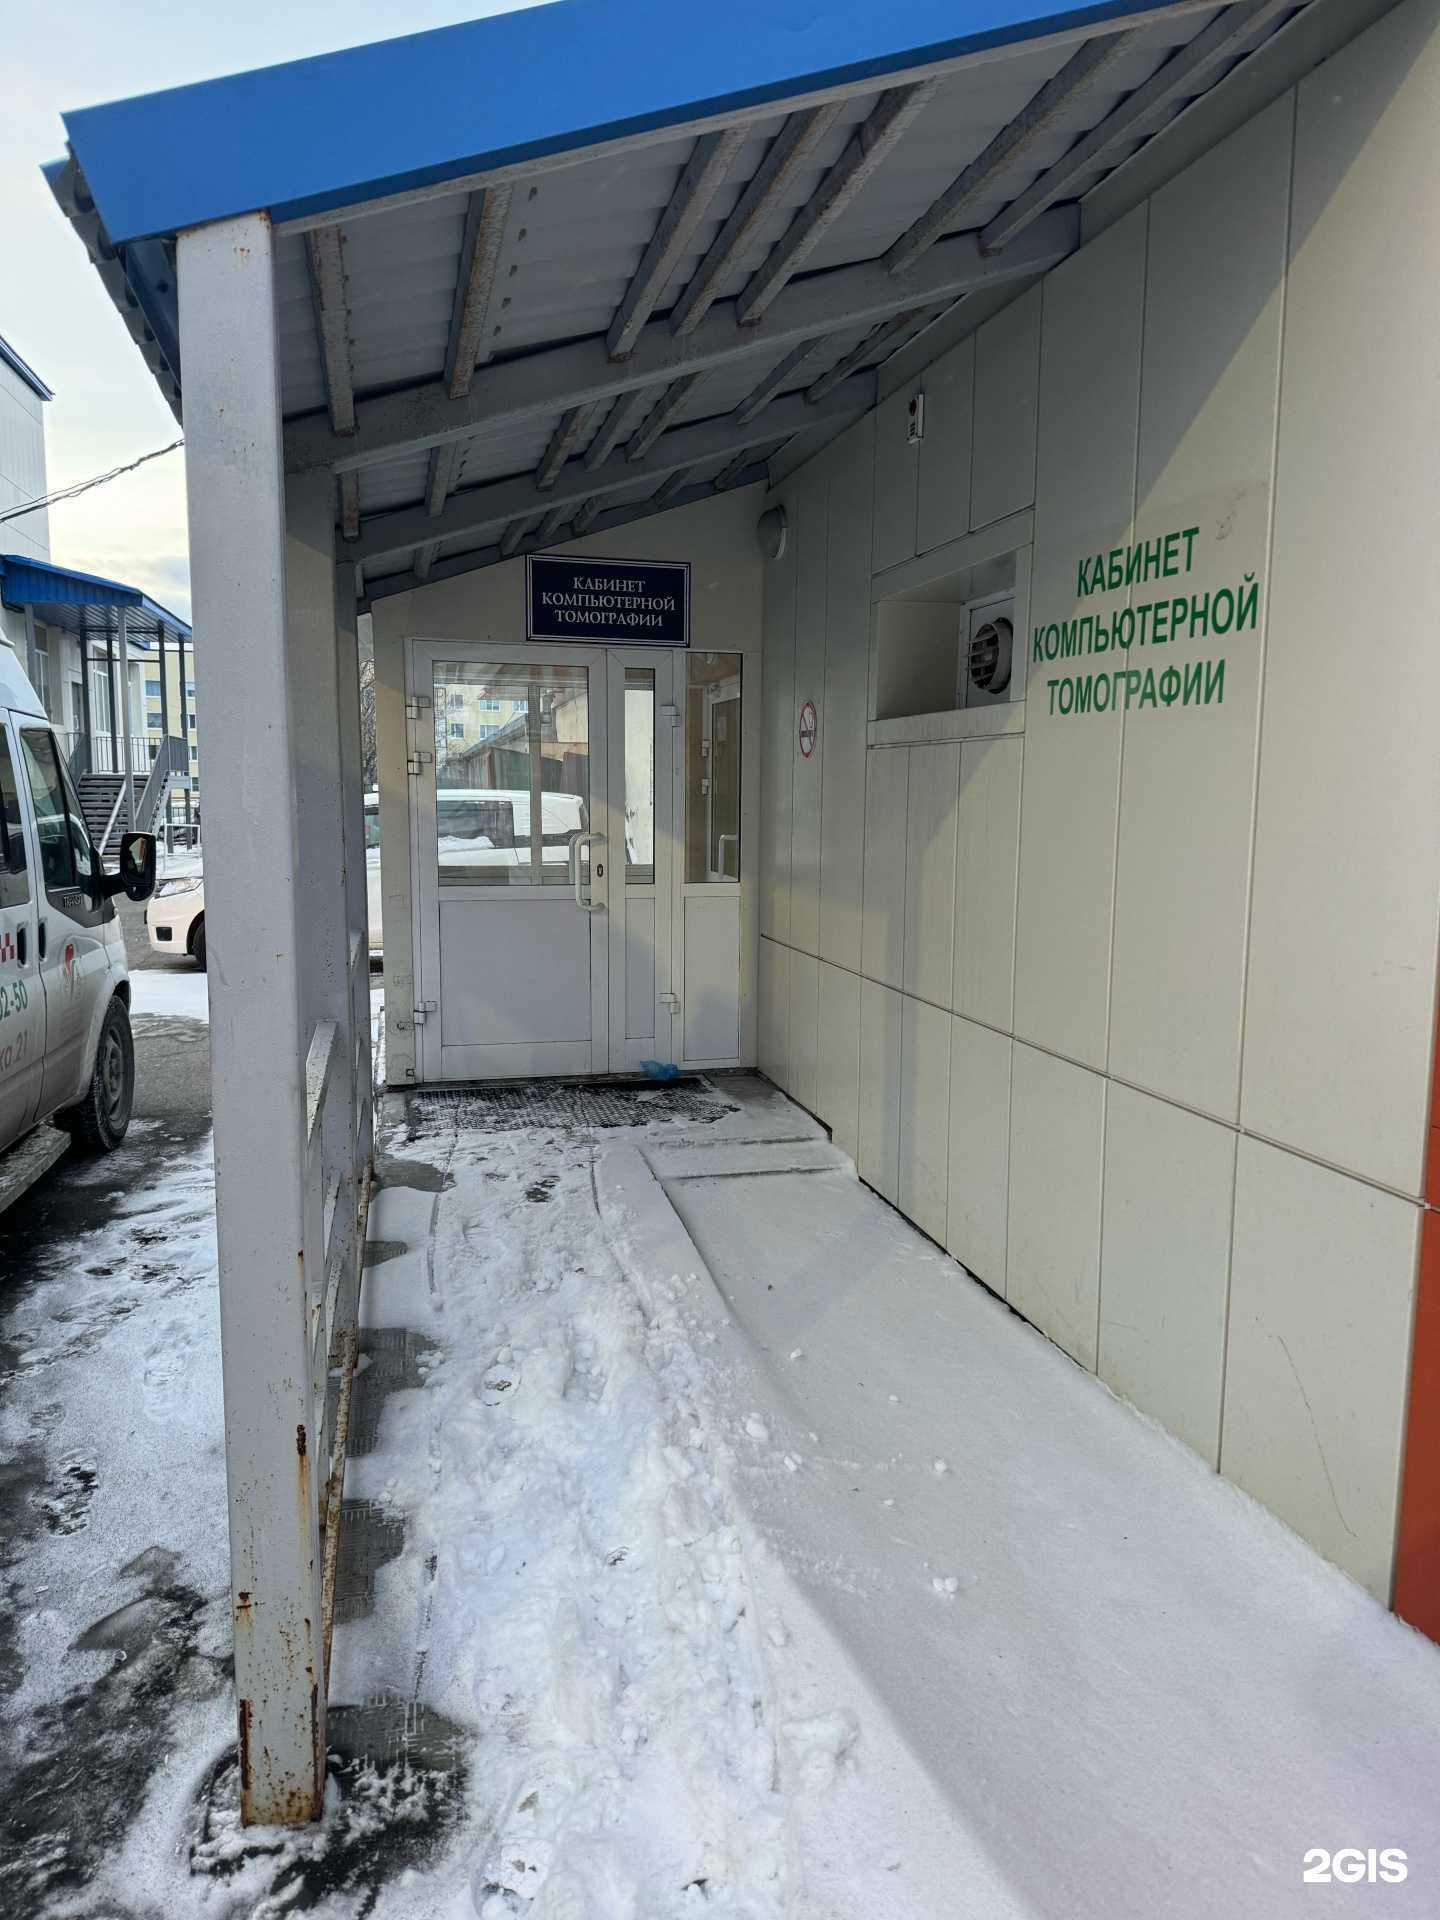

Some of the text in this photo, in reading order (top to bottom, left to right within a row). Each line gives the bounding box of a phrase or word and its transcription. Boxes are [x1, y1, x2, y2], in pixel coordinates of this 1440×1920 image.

[1077, 526, 1200, 597] КАБИНЕТ
[542, 592, 676, 611] КОМПЬЮТЕРНОЙ
[573, 576, 646, 593] КАБИНЕТ
[555, 609, 664, 627] ТОМОГРАФИИ
[1033, 571, 1259, 663] КОМПЬЮТЕРНОЙ
[1047, 658, 1226, 716] ТОМОГРАФИИ
